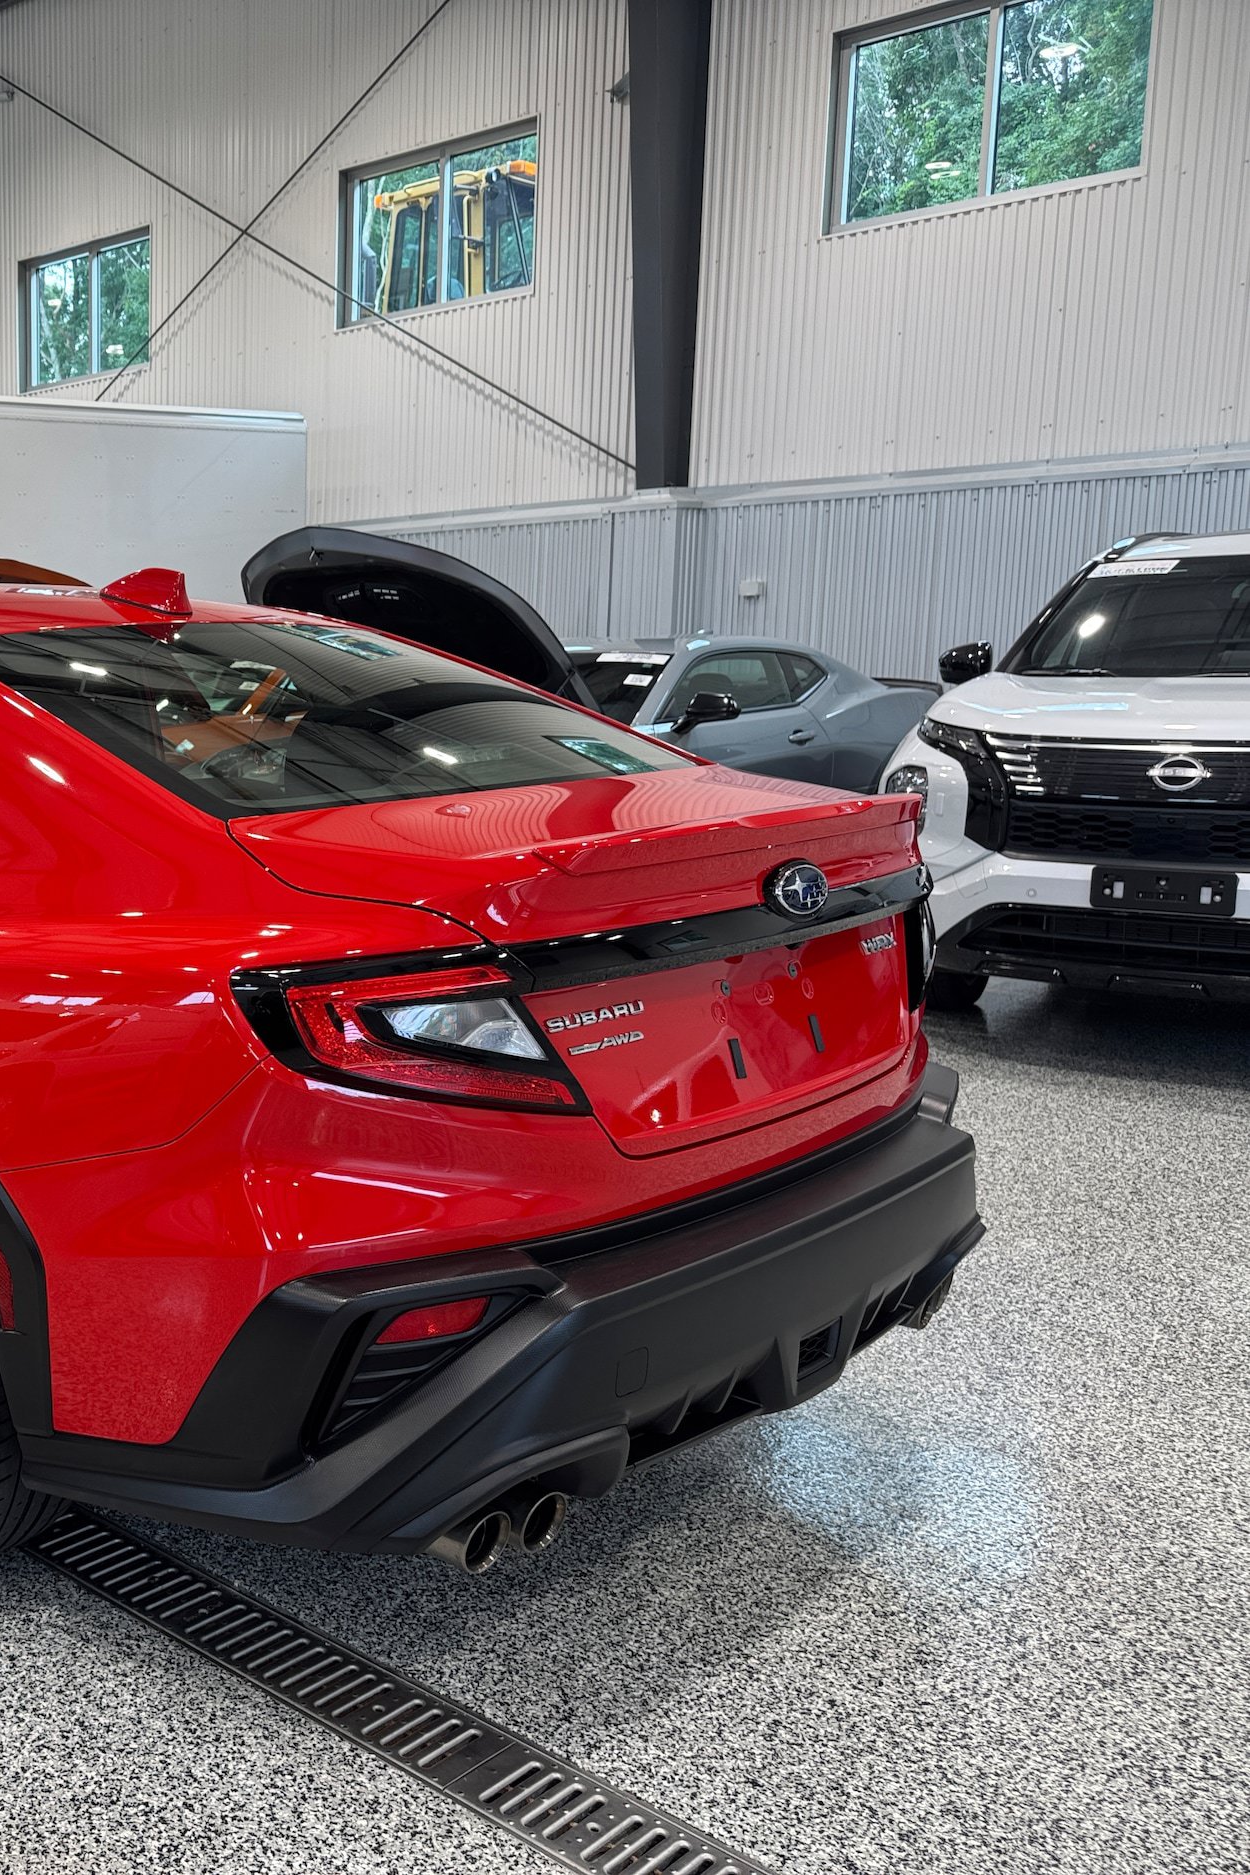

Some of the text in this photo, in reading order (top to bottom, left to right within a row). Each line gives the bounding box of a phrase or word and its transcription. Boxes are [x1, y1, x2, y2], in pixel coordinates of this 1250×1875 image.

[860, 931, 897, 955] WRX
[546, 1000, 645, 1033] SUBARU
[600, 1031, 645, 1050] AWD
